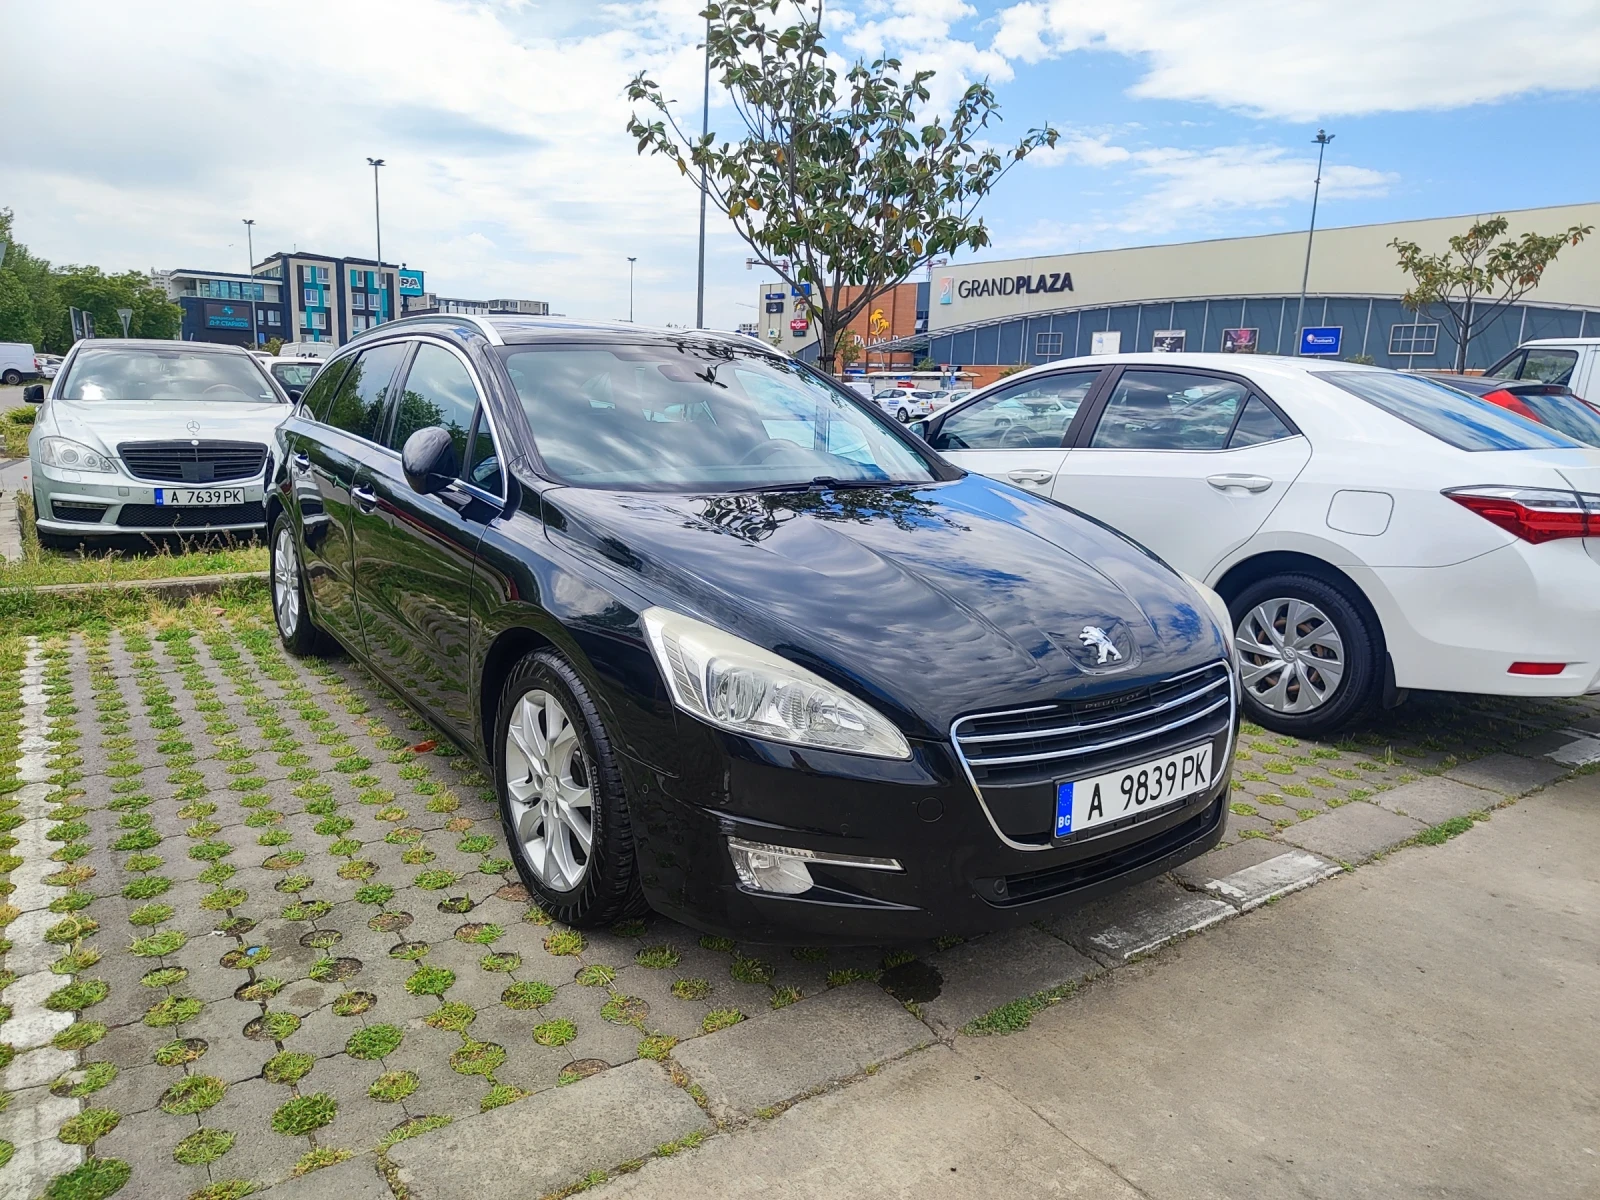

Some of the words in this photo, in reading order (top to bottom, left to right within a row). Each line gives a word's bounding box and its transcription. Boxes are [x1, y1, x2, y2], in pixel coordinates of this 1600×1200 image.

[170, 490, 179, 503] A
[1085, 692, 1141, 709] PEUGEOT
[591, 765, 603, 834] RainSport
[1087, 782, 1104, 821] A
[1058, 815, 1071, 828] BG
